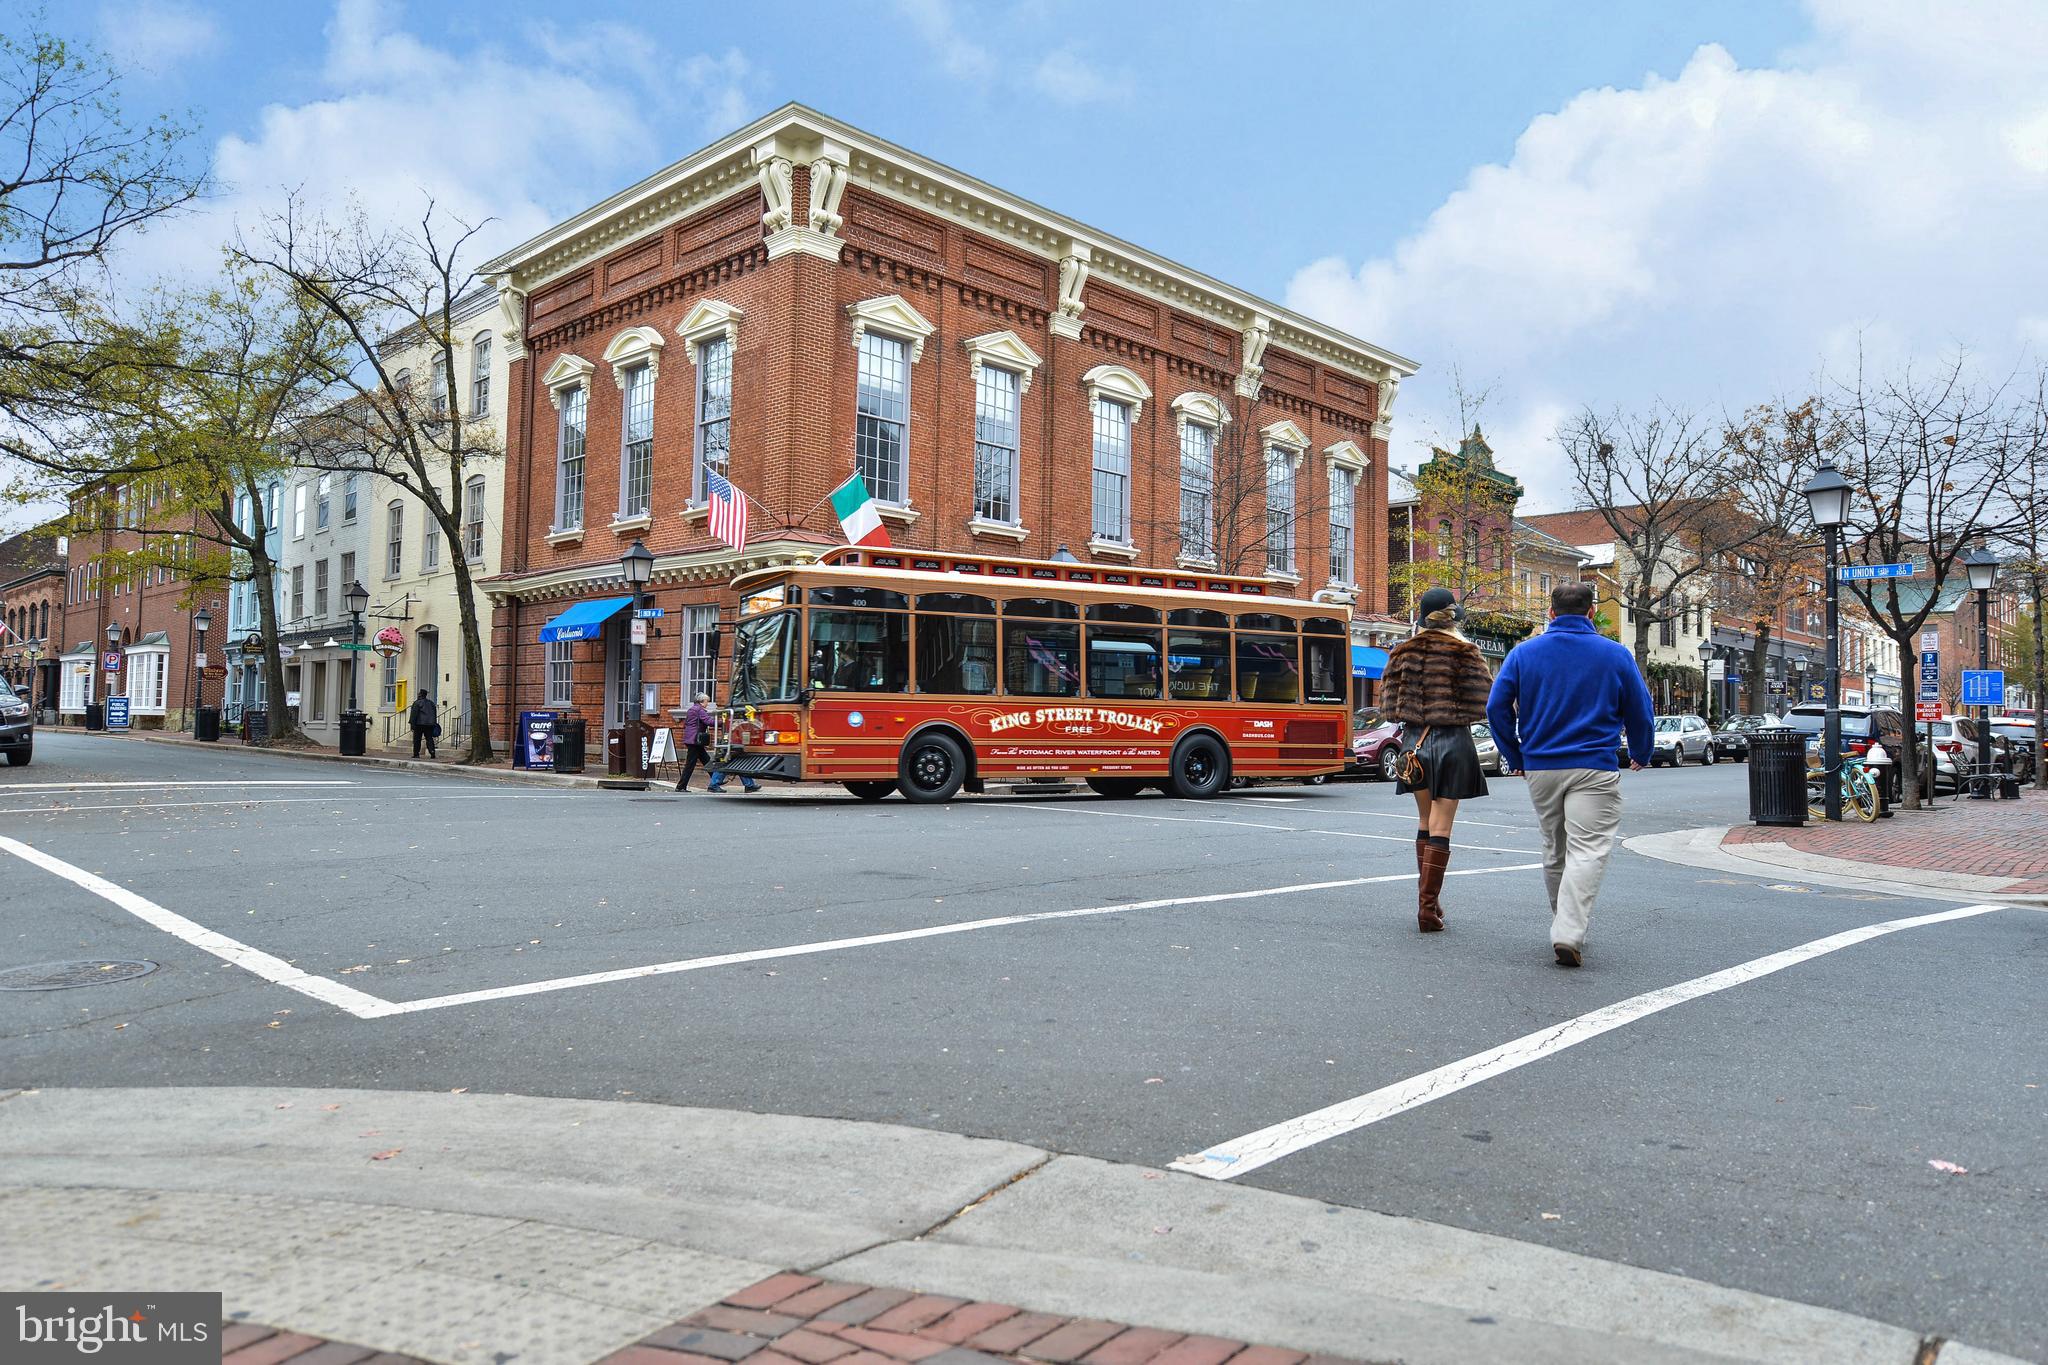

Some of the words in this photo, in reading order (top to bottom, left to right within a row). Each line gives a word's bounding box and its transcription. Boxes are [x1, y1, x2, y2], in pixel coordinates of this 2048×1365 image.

[1844, 568, 1849, 578] N
[1852, 568, 1874, 578] UNION
[1476, 638, 1504, 652] CREAM
[1926, 654, 1933, 662] P
[989, 711, 1031, 733] KING
[1036, 708, 1094, 724] STREET
[1098, 710, 1164, 735] TROLLEY
